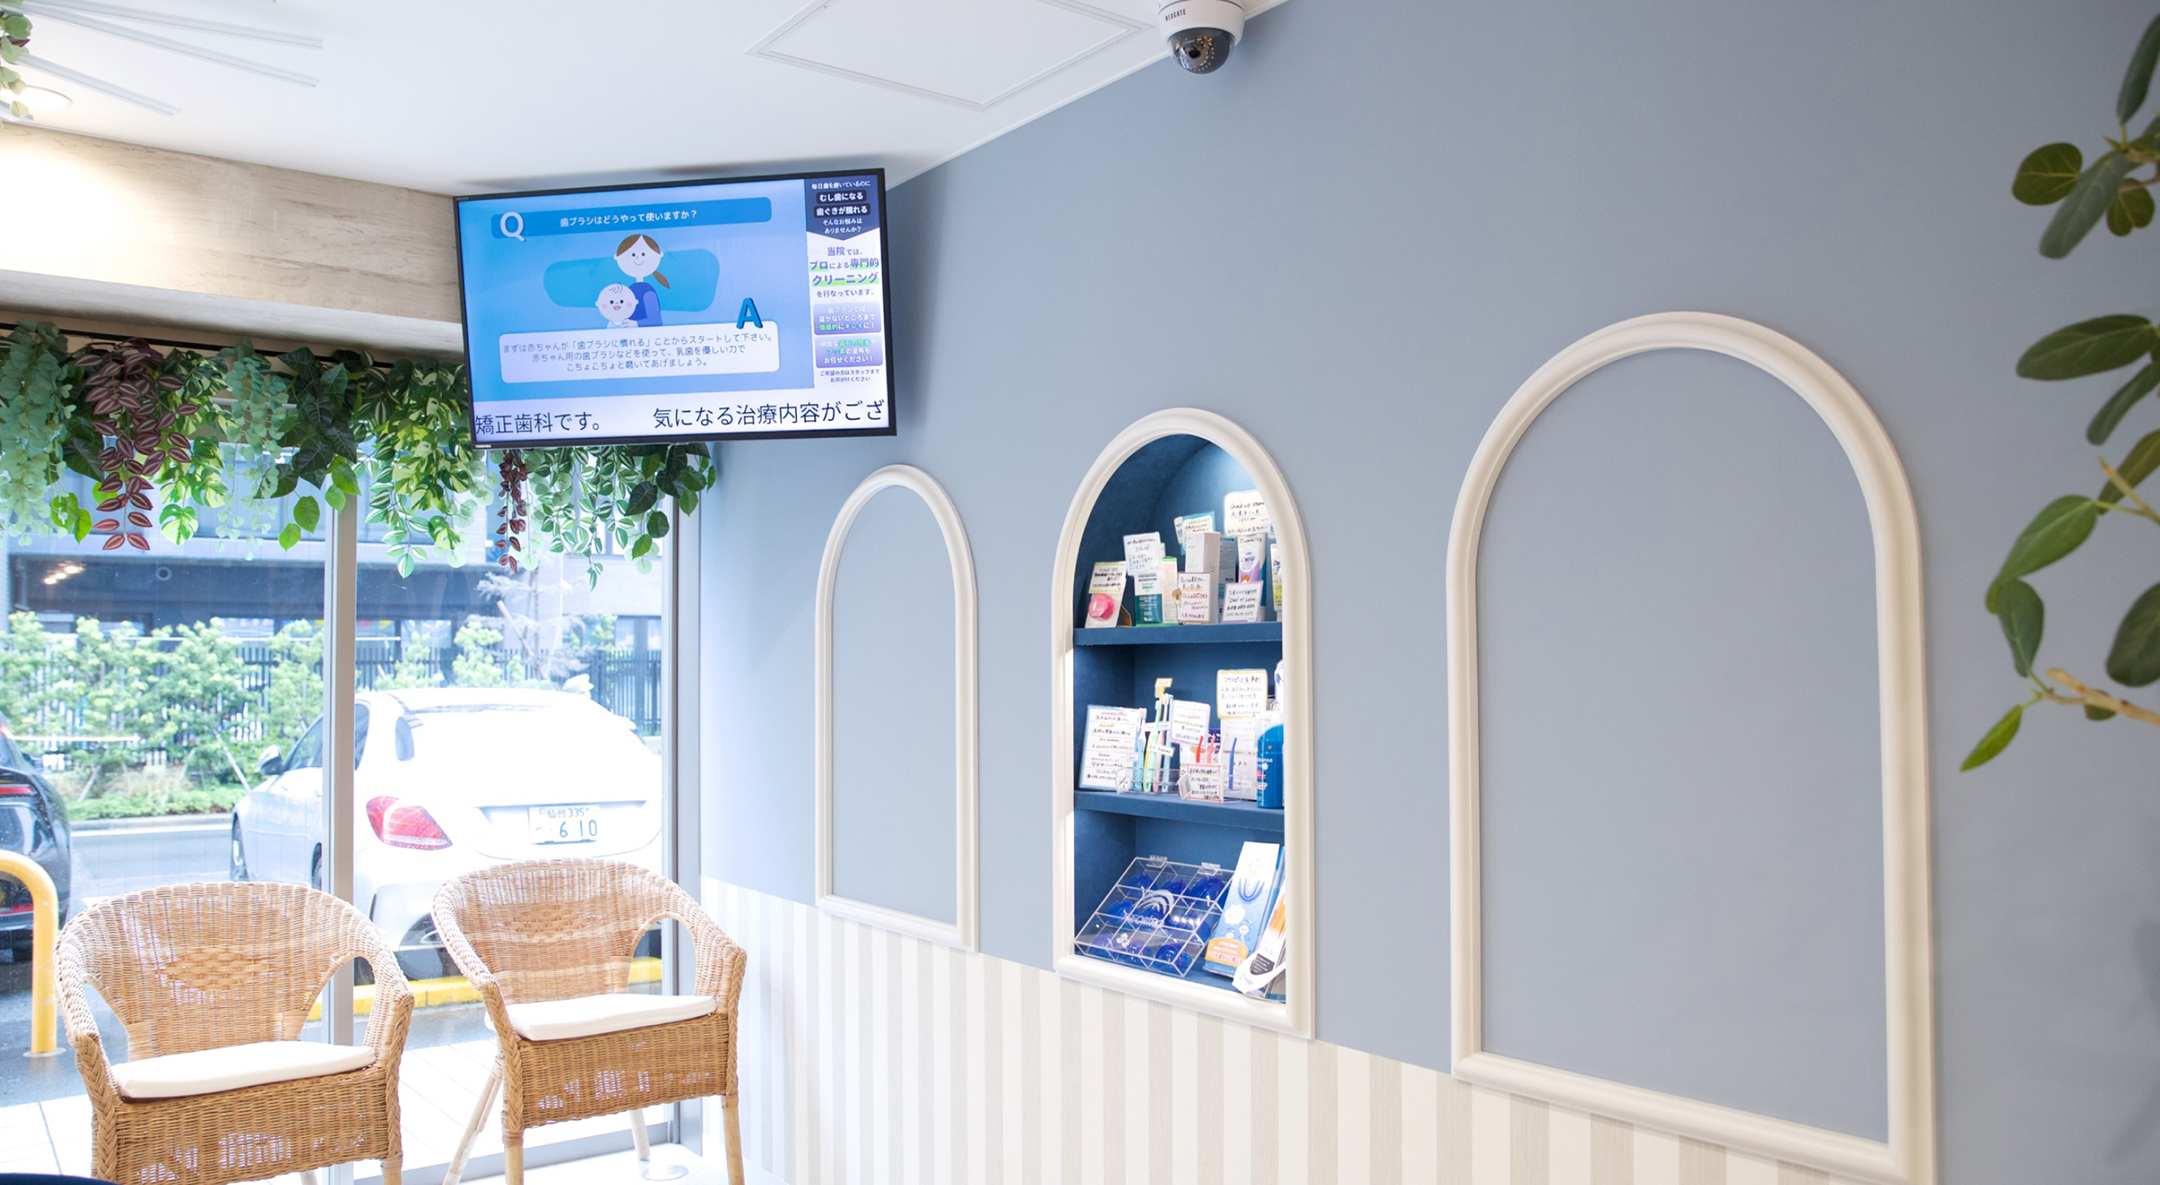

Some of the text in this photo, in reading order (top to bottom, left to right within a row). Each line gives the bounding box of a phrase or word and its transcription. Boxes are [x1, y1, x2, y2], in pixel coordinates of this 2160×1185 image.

[819, 192, 864, 202] むし歯になる
[816, 205, 868, 216] 歯ぐきが腫れる
[560, 209, 697, 228] 歯ブラシはどうやって使いますか？
[823, 217, 863, 226] そんなお悩みは
[500, 211, 526, 241] Q
[824, 226, 861, 234] ありませんか？
[827, 246, 863, 256] 当院では、
[809, 257, 879, 270] プロによる専門的
[812, 271, 878, 286] クリーニング
[816, 288, 874, 298] を行なっています。
[736, 297, 764, 330] A
[827, 306, 866, 314] 歯ブラシでは
[819, 314, 875, 323] 届かないところまで
[503, 333, 772, 354] まずは赤ちゃんが「歯ブラシに慣れる」ことからスタートして下さい。
[532, 345, 745, 363] 赤ちゃん用の歯ブラシなどを使って、乳歯を優しい力で
[824, 355, 873, 364] お任せください！
[567, 357, 707, 372] こちょこちょと磨いてあげましょう。
[474, 398, 885, 436] 矯正歯科です。 気になる治療内容がござ
[568, 807, 586, 818] 335
